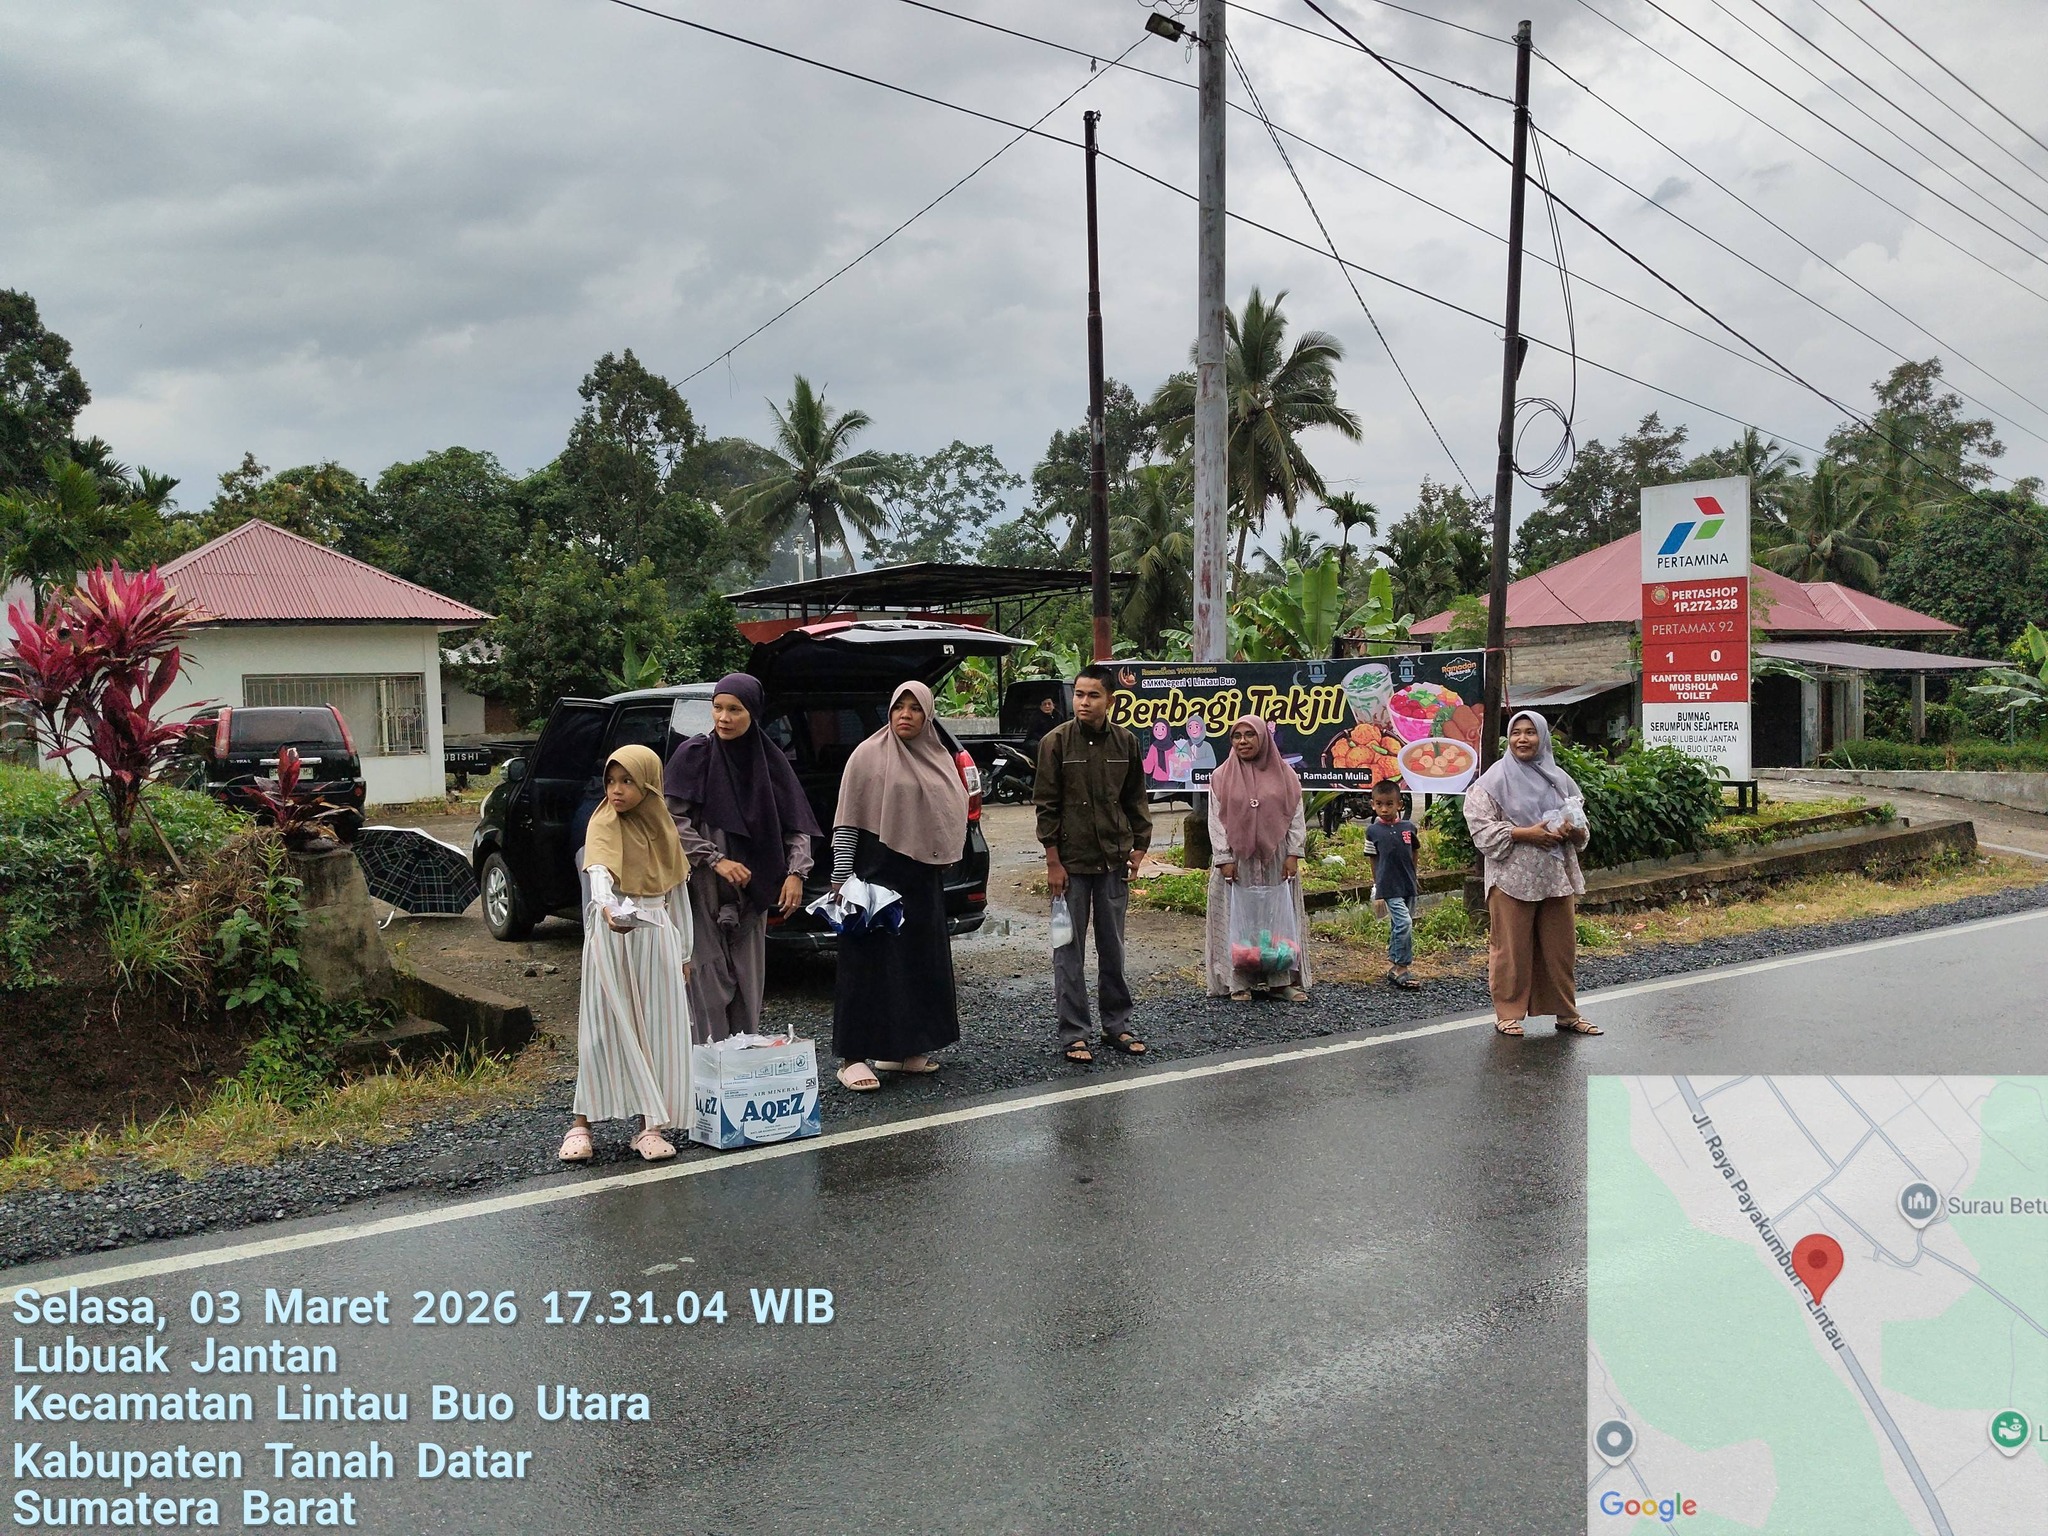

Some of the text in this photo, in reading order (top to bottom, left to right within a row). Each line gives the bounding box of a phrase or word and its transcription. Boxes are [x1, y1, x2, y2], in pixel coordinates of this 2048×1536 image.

[1657, 552, 1729, 569] PERTAMINA
[1671, 586, 1738, 601] PERTASHOP
[1673, 599, 1738, 613] 1P.272.328
[1652, 620, 1734, 635] PERTAMAX 92
[1665, 649, 1721, 664] 1 0
[1142, 676, 1237, 689] SMK Negeri 1 Lintau Buo
[1651, 672, 1738, 683] KANTOR BUMNAG
[1669, 682, 1718, 691] MUSHOLA
[1676, 691, 1712, 700] TOILET
[1110, 687, 1346, 734] Berbagi Takjil
[1677, 711, 1711, 721] BUMNAG
[1650, 721, 1739, 731] SERUMPUN SEJAHTERA
[1652, 734, 1737, 743] NAGARI LUBUAK JANTAN
[1687, 745, 1702, 753] BUO
[1703, 744, 1727, 753] UTARA
[1303, 771, 1343, 780] Ramadan
[767, 1086, 800, 1095] MINERAL
[740, 1092, 805, 1123] AQEZ
